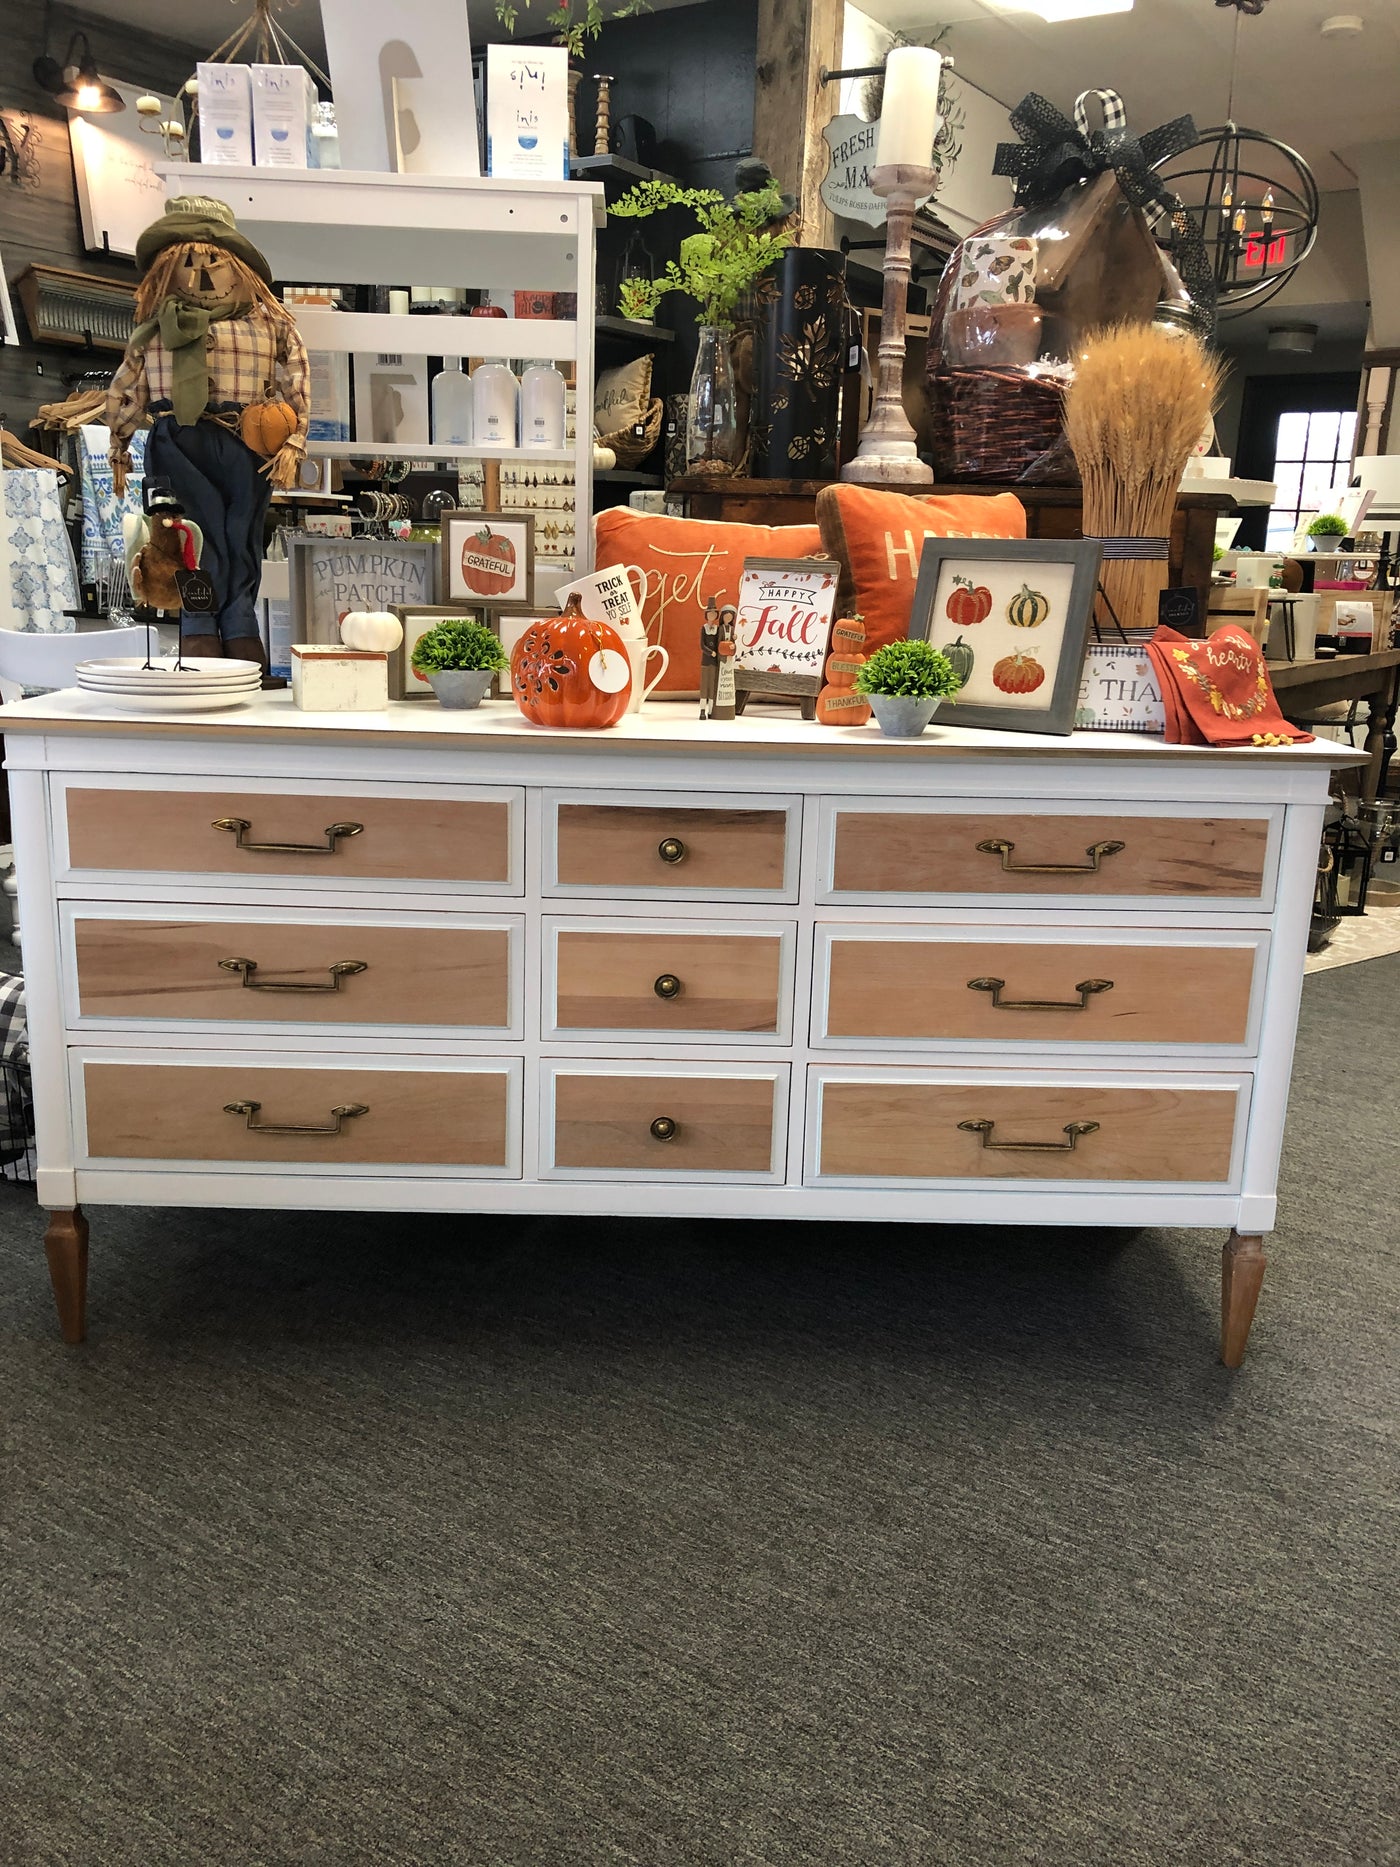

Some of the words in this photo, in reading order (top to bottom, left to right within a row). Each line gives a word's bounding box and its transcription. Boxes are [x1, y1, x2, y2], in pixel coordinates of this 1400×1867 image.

[211, 71, 235, 89] inis
[265, 73, 290, 92] inis
[516, 110, 538, 127] inis
[832, 127, 875, 169] FRESH
[844, 165, 876, 190] MA
[829, 192, 848, 207] TULIPS
[849, 200, 868, 210] ROSES
[1244, 229, 1286, 266] EXIT
[313, 554, 426, 585] PUMPKIN
[467, 554, 511, 575] GRATEFUL
[334, 583, 407, 604] PATCH
[594, 575, 624, 595] TRICK
[767, 589, 806, 600] HAPPY
[601, 591, 629, 611] TREAT
[617, 601, 632, 617] SELF
[740, 605, 819, 648] Fall
[835, 627, 864, 642] GRATEFUL
[1099, 679, 1164, 703] THA
[827, 694, 868, 709] THANKFUL
